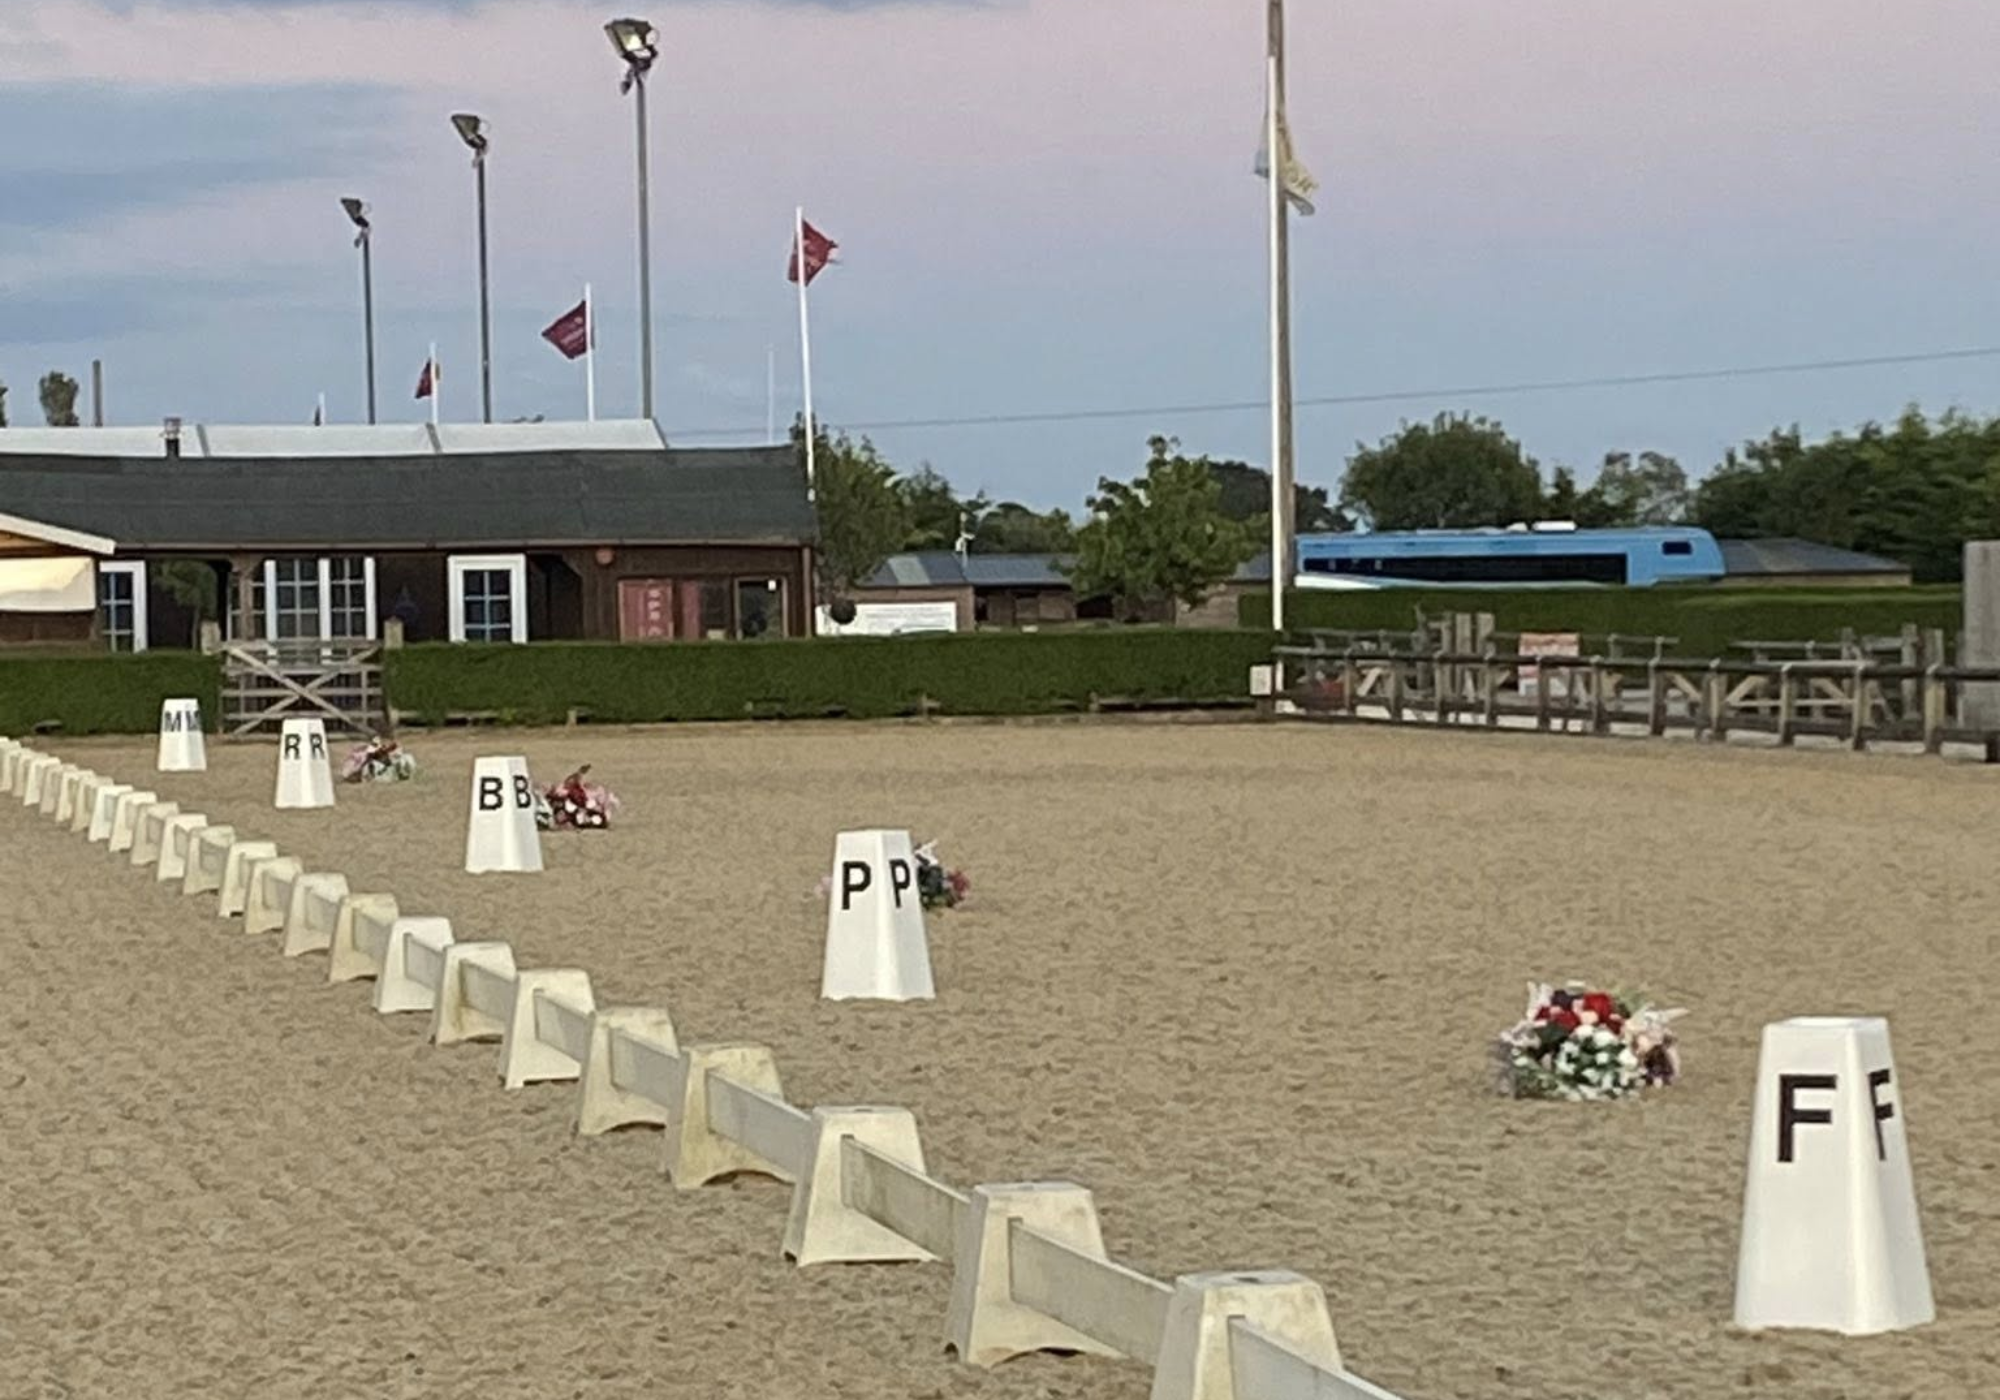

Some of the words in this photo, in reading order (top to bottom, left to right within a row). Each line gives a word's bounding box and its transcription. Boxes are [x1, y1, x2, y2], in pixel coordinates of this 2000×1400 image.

[164, 711, 182, 732] M
[284, 733, 301, 760] R
[309, 732, 326, 760] R
[479, 776, 503, 810] B
[513, 775, 531, 809] B
[842, 861, 871, 910] P
[889, 859, 911, 908] P
[1777, 1074, 1837, 1163] F
[1868, 1068, 1894, 1161] F
